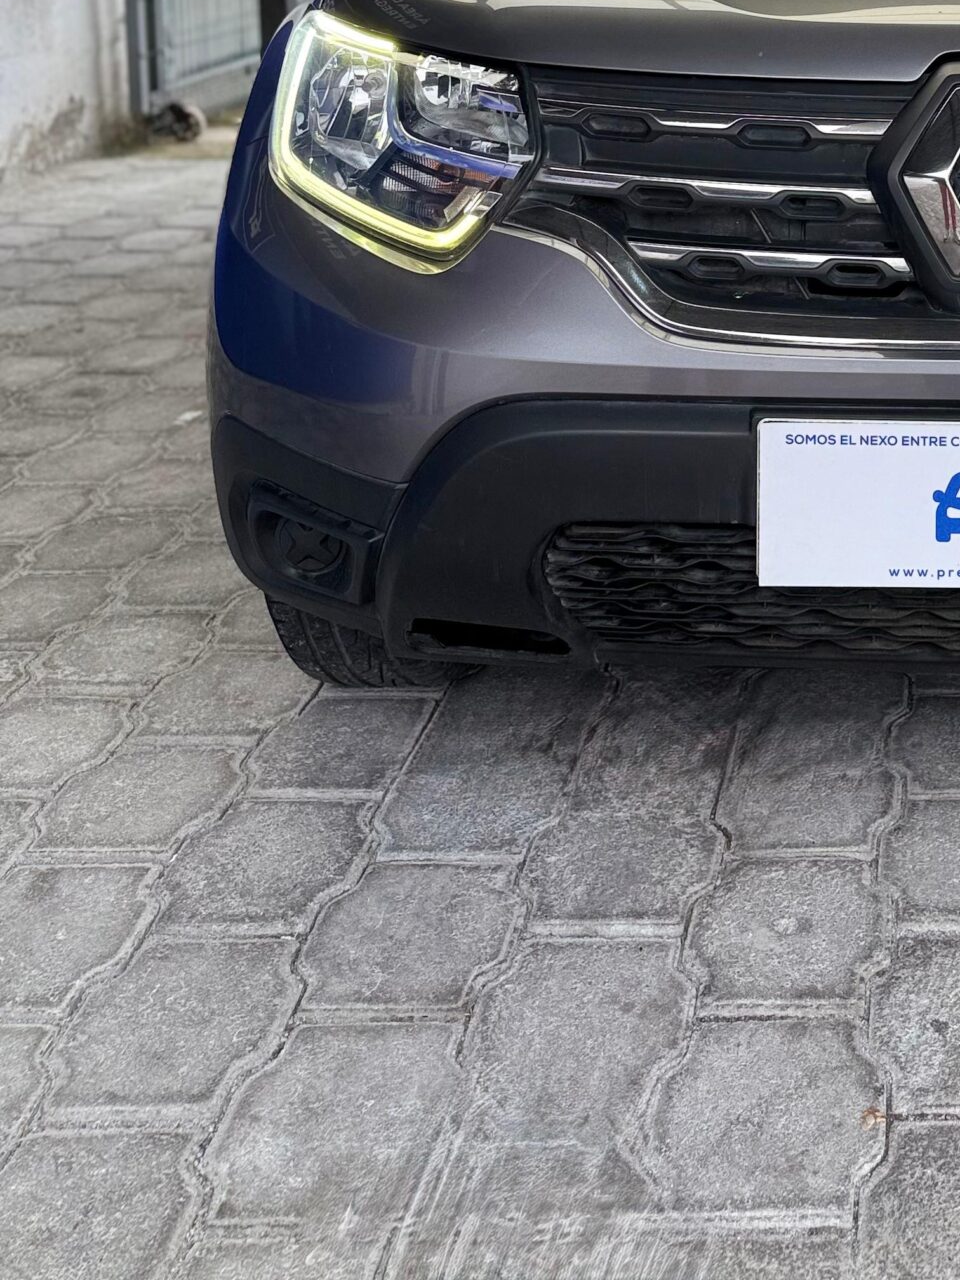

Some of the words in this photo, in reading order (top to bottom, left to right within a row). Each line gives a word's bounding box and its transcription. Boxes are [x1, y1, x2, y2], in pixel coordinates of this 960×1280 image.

[785, 434, 836, 445] SOMOS
[840, 434, 856, 446] EL
[859, 435, 898, 446] NEXO
[901, 436, 947, 447] ENTRE
